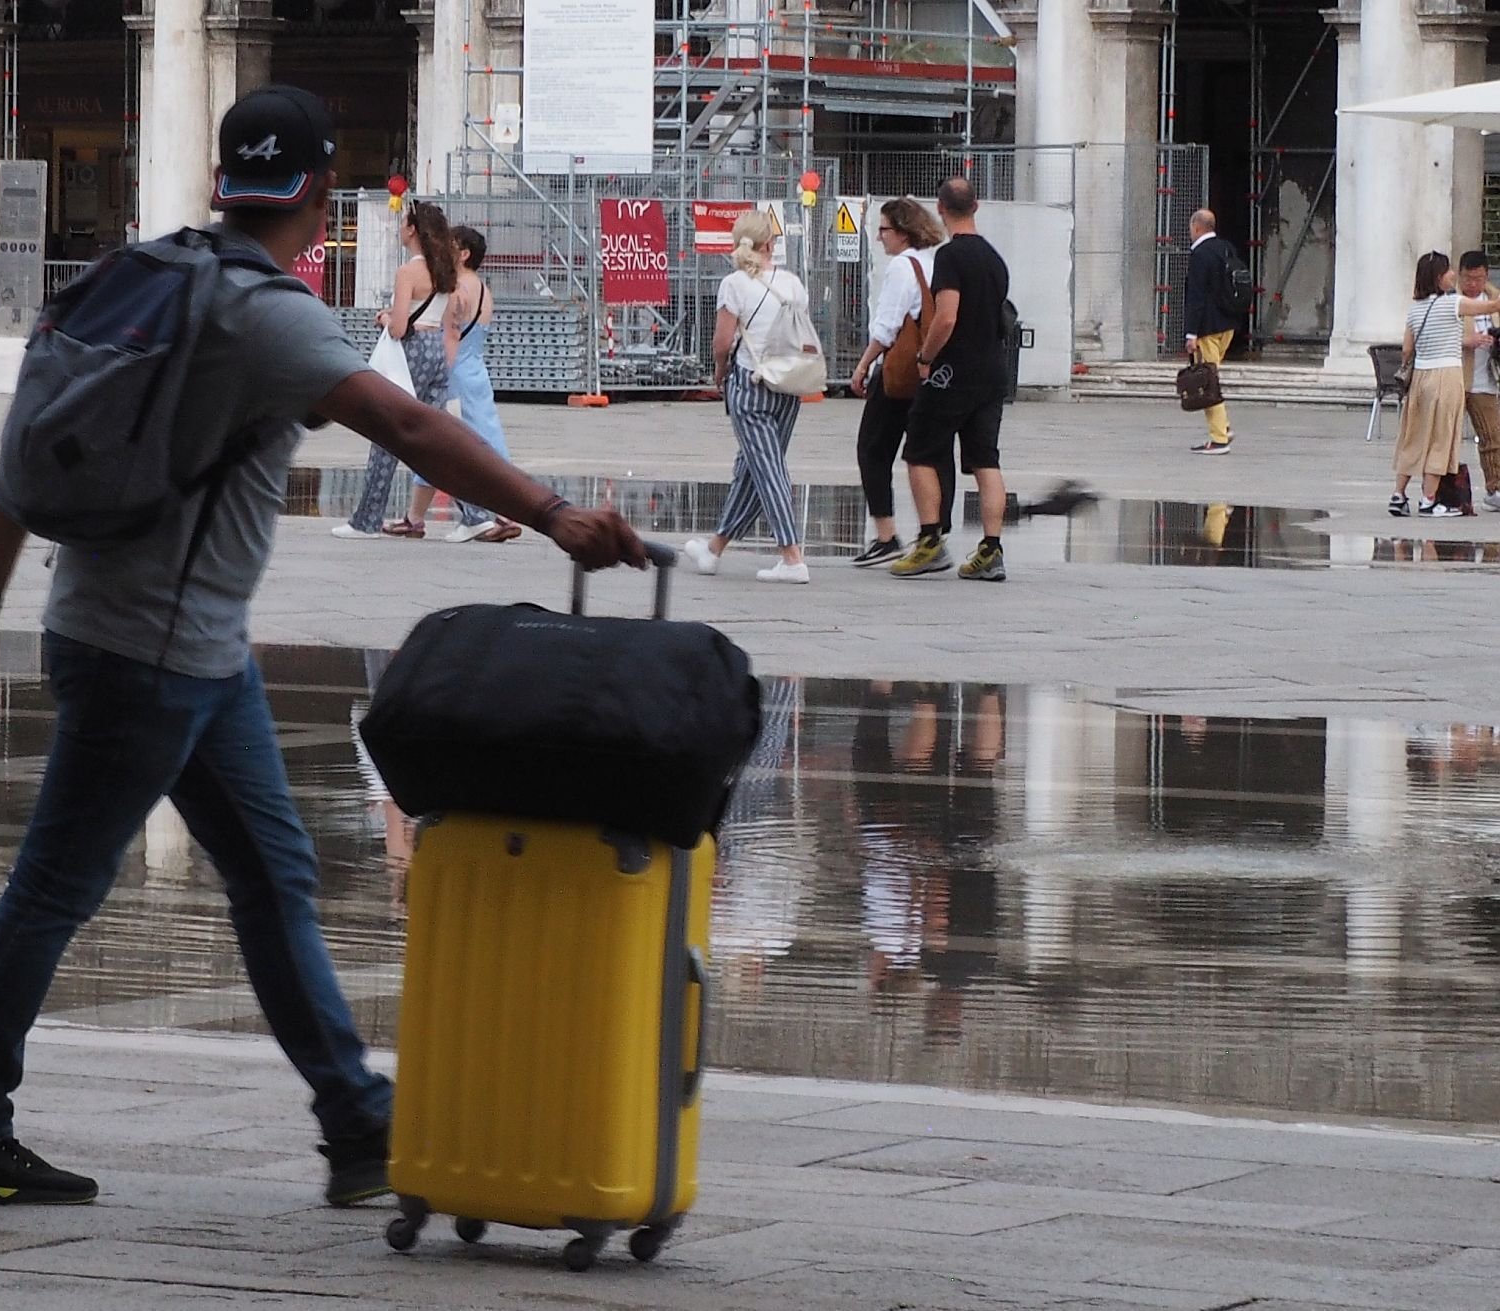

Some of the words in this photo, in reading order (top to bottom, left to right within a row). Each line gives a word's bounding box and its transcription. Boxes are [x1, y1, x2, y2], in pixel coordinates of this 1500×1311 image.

[34, 96, 102, 113] AURORA
[601, 233, 651, 252] DUCALE
[602, 252, 668, 271] RESTAURO
